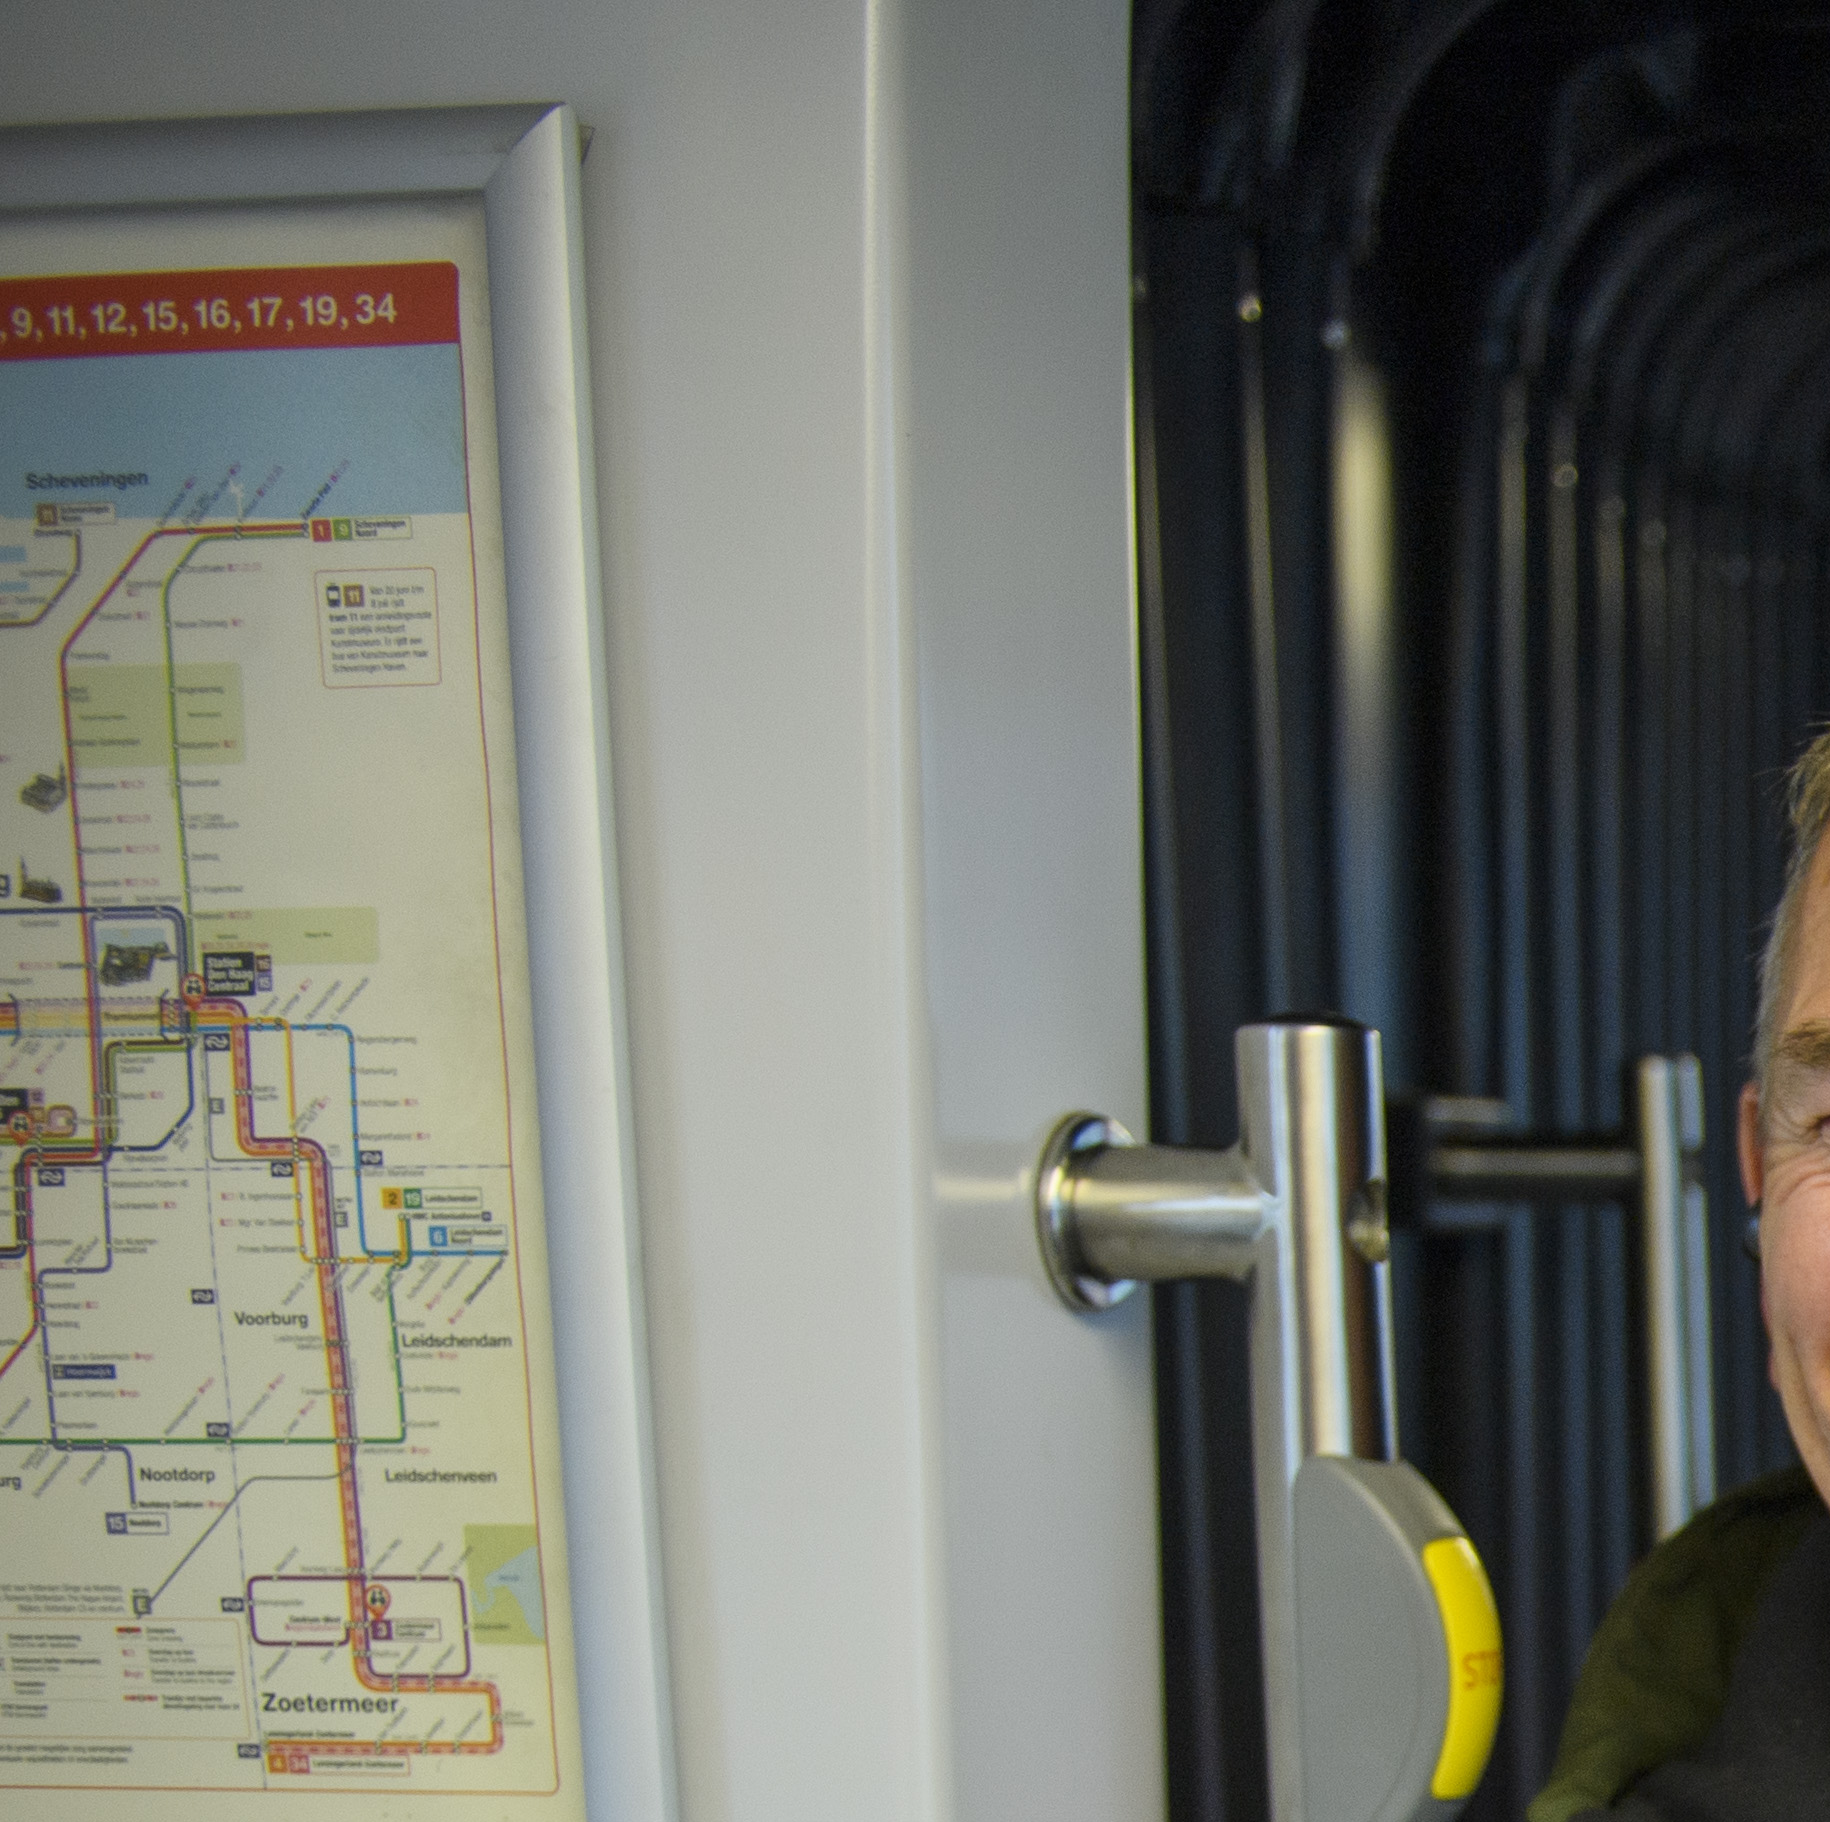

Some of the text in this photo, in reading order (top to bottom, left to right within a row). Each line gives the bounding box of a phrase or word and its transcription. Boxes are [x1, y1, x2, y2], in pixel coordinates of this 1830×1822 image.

[356, 292, 398, 325] 34
[26, 471, 150, 490] Scheveningen
[388, 1191, 399, 1206] 2
[404, 1192, 421, 1207] 19
[433, 1229, 445, 1245] 6
[233, 1310, 309, 1330] Voorburg
[401, 1332, 513, 1349] Leidschendam
[139, 1466, 216, 1484] Nootdorp
[384, 1467, 498, 1483] Leidschenveen
[108, 1516, 126, 1531] 15
[262, 1691, 399, 1714] Zoetermeer
